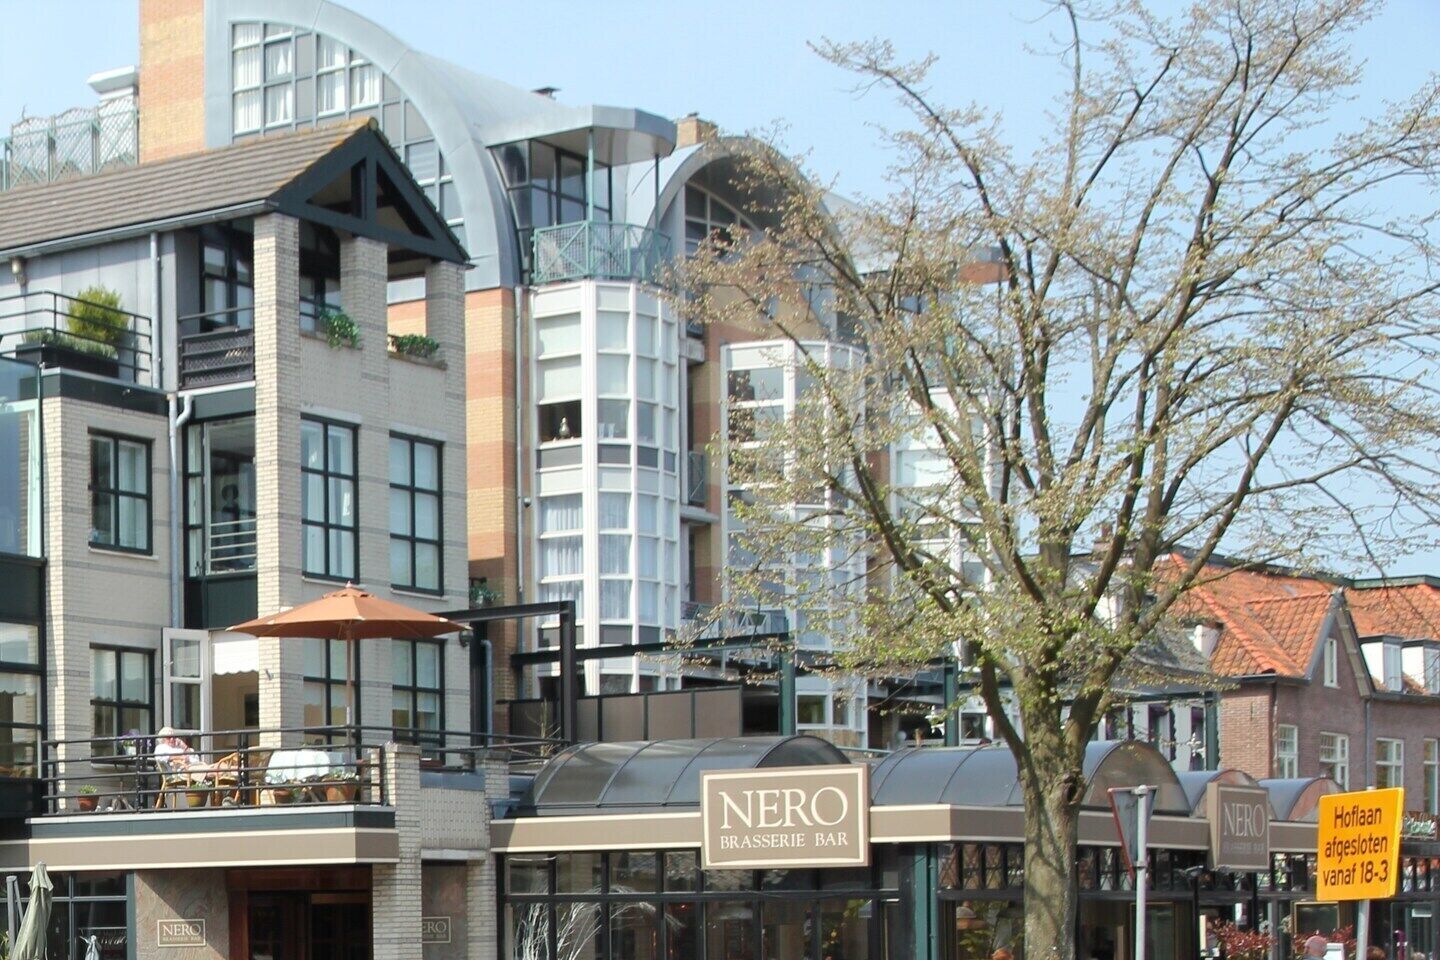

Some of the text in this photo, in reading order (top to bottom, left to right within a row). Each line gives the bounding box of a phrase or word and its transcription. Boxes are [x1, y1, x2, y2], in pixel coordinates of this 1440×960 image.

[718, 786, 848, 830] NERO
[1223, 802, 1266, 838] NERO
[1333, 804, 1382, 829] Hoflaan
[720, 831, 849, 850] BRASSERIE BAR
[1324, 832, 1389, 863] afgesloten
[1322, 858, 1389, 887] vanaf 18-3
[162, 923, 202, 936] NERO
